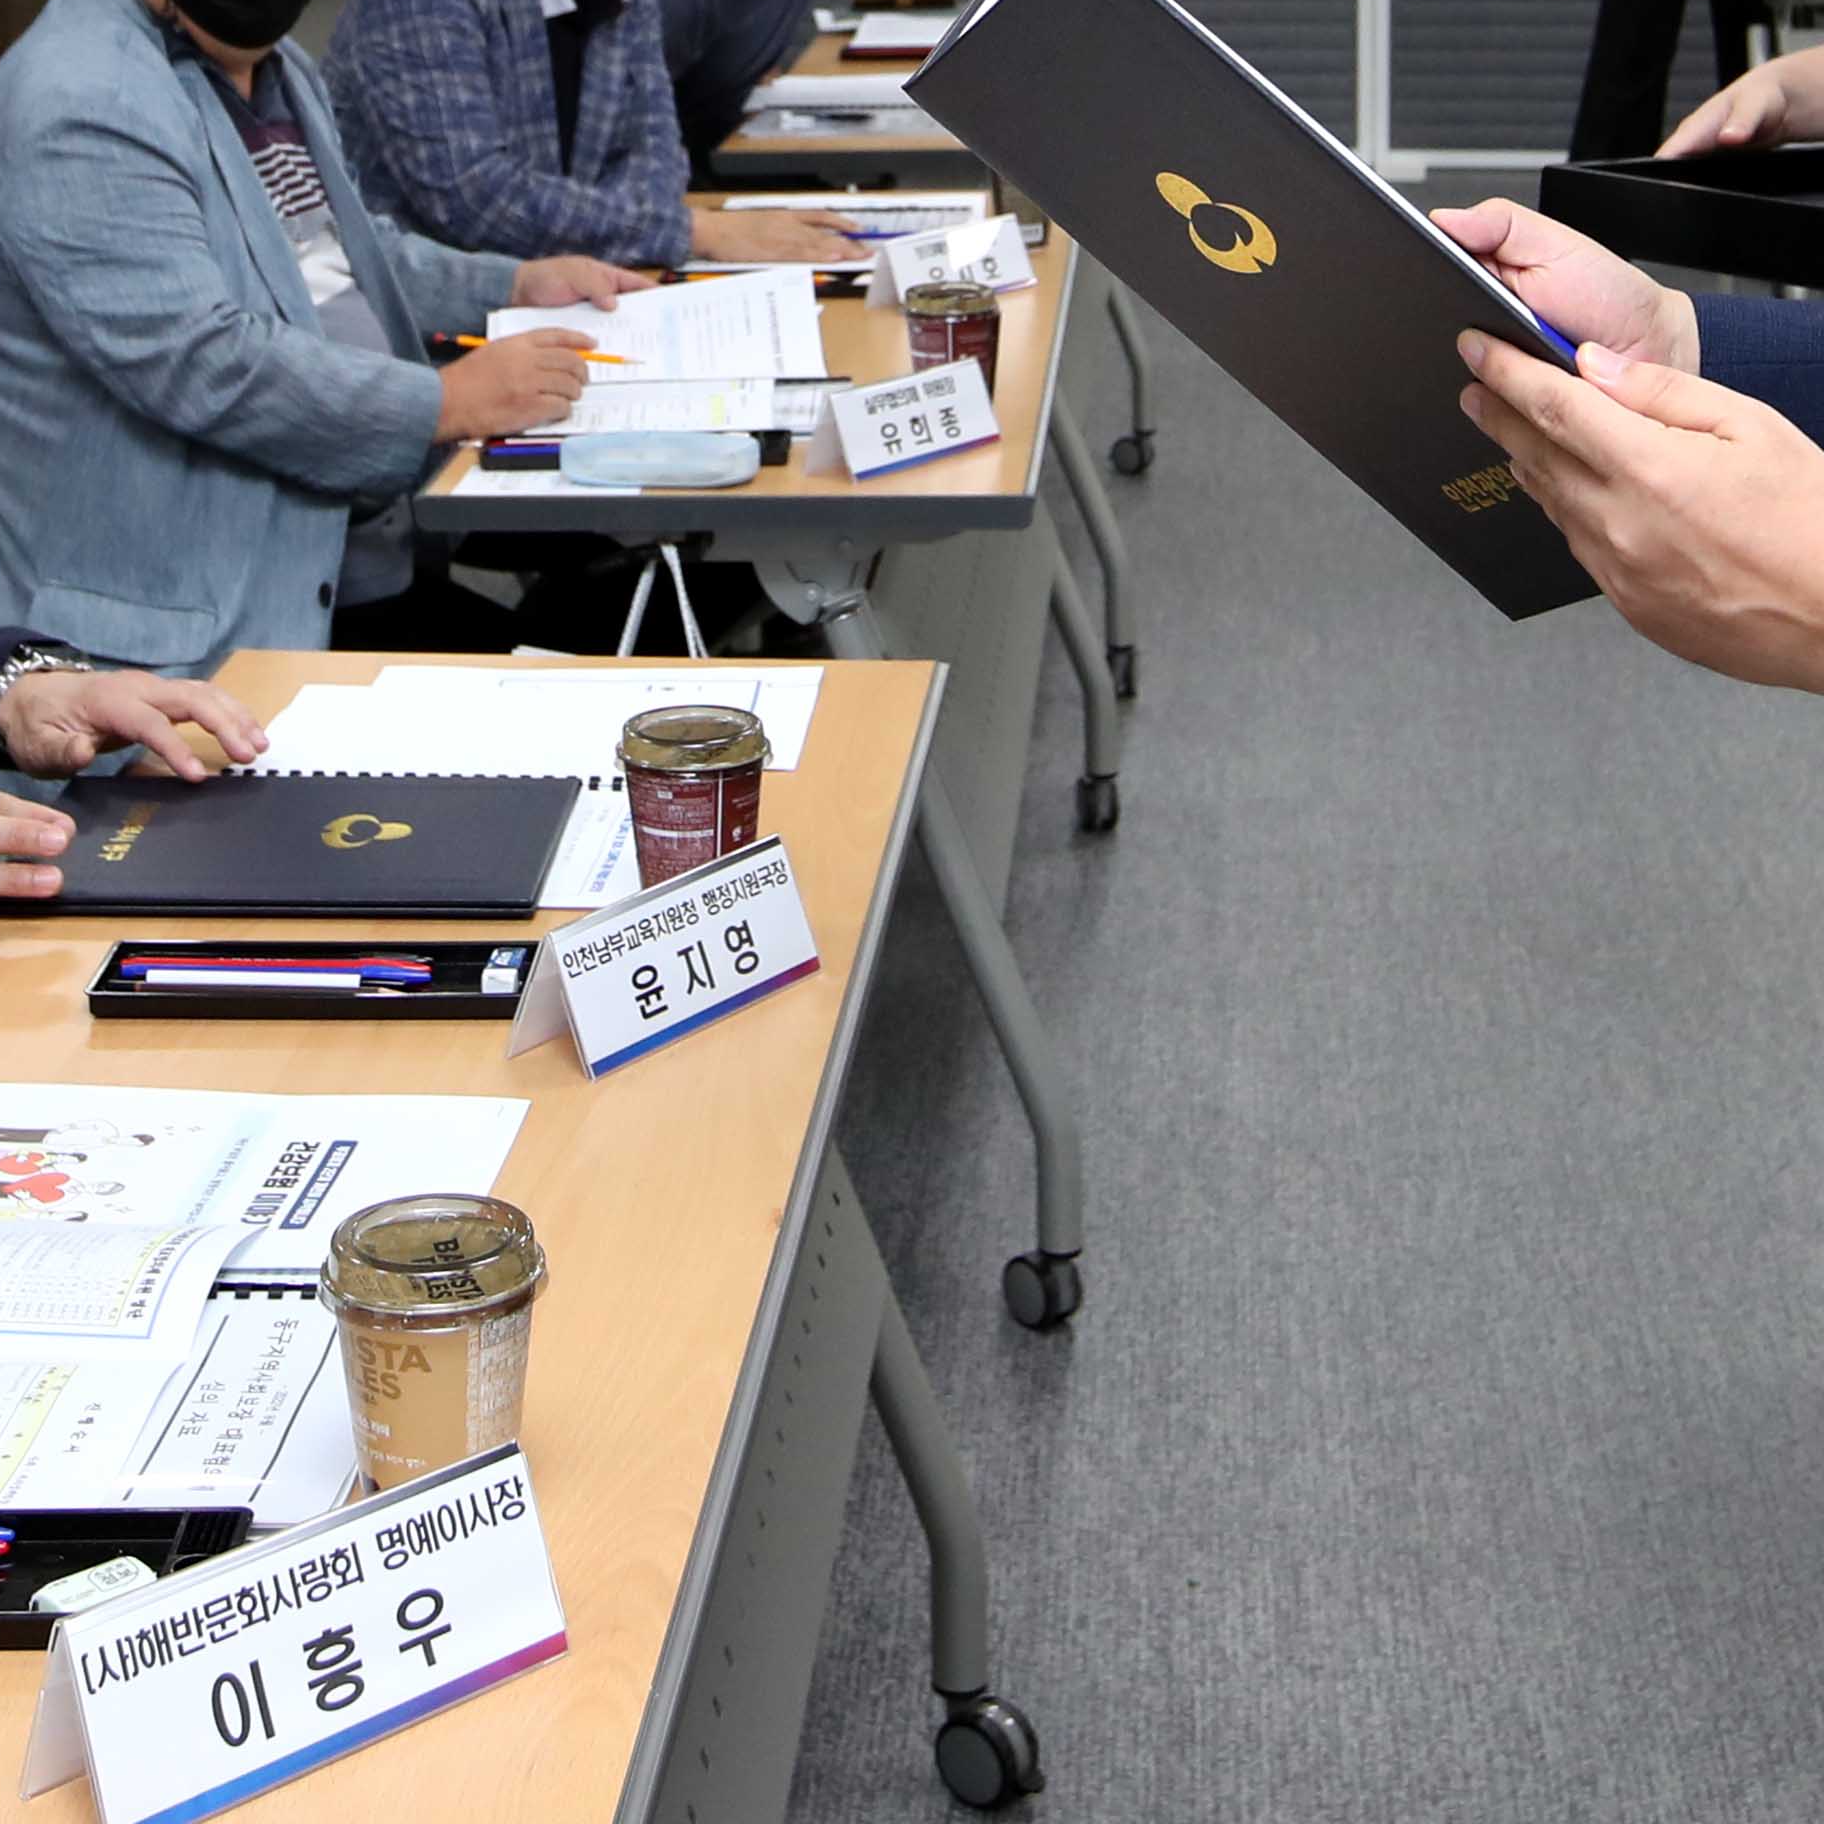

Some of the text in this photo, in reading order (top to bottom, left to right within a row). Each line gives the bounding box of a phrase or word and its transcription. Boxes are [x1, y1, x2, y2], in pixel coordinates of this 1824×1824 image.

[562, 858, 789, 979] 인천남부교육지원청 행정지원국장
[376, 1475, 527, 1571] 명예이사장
